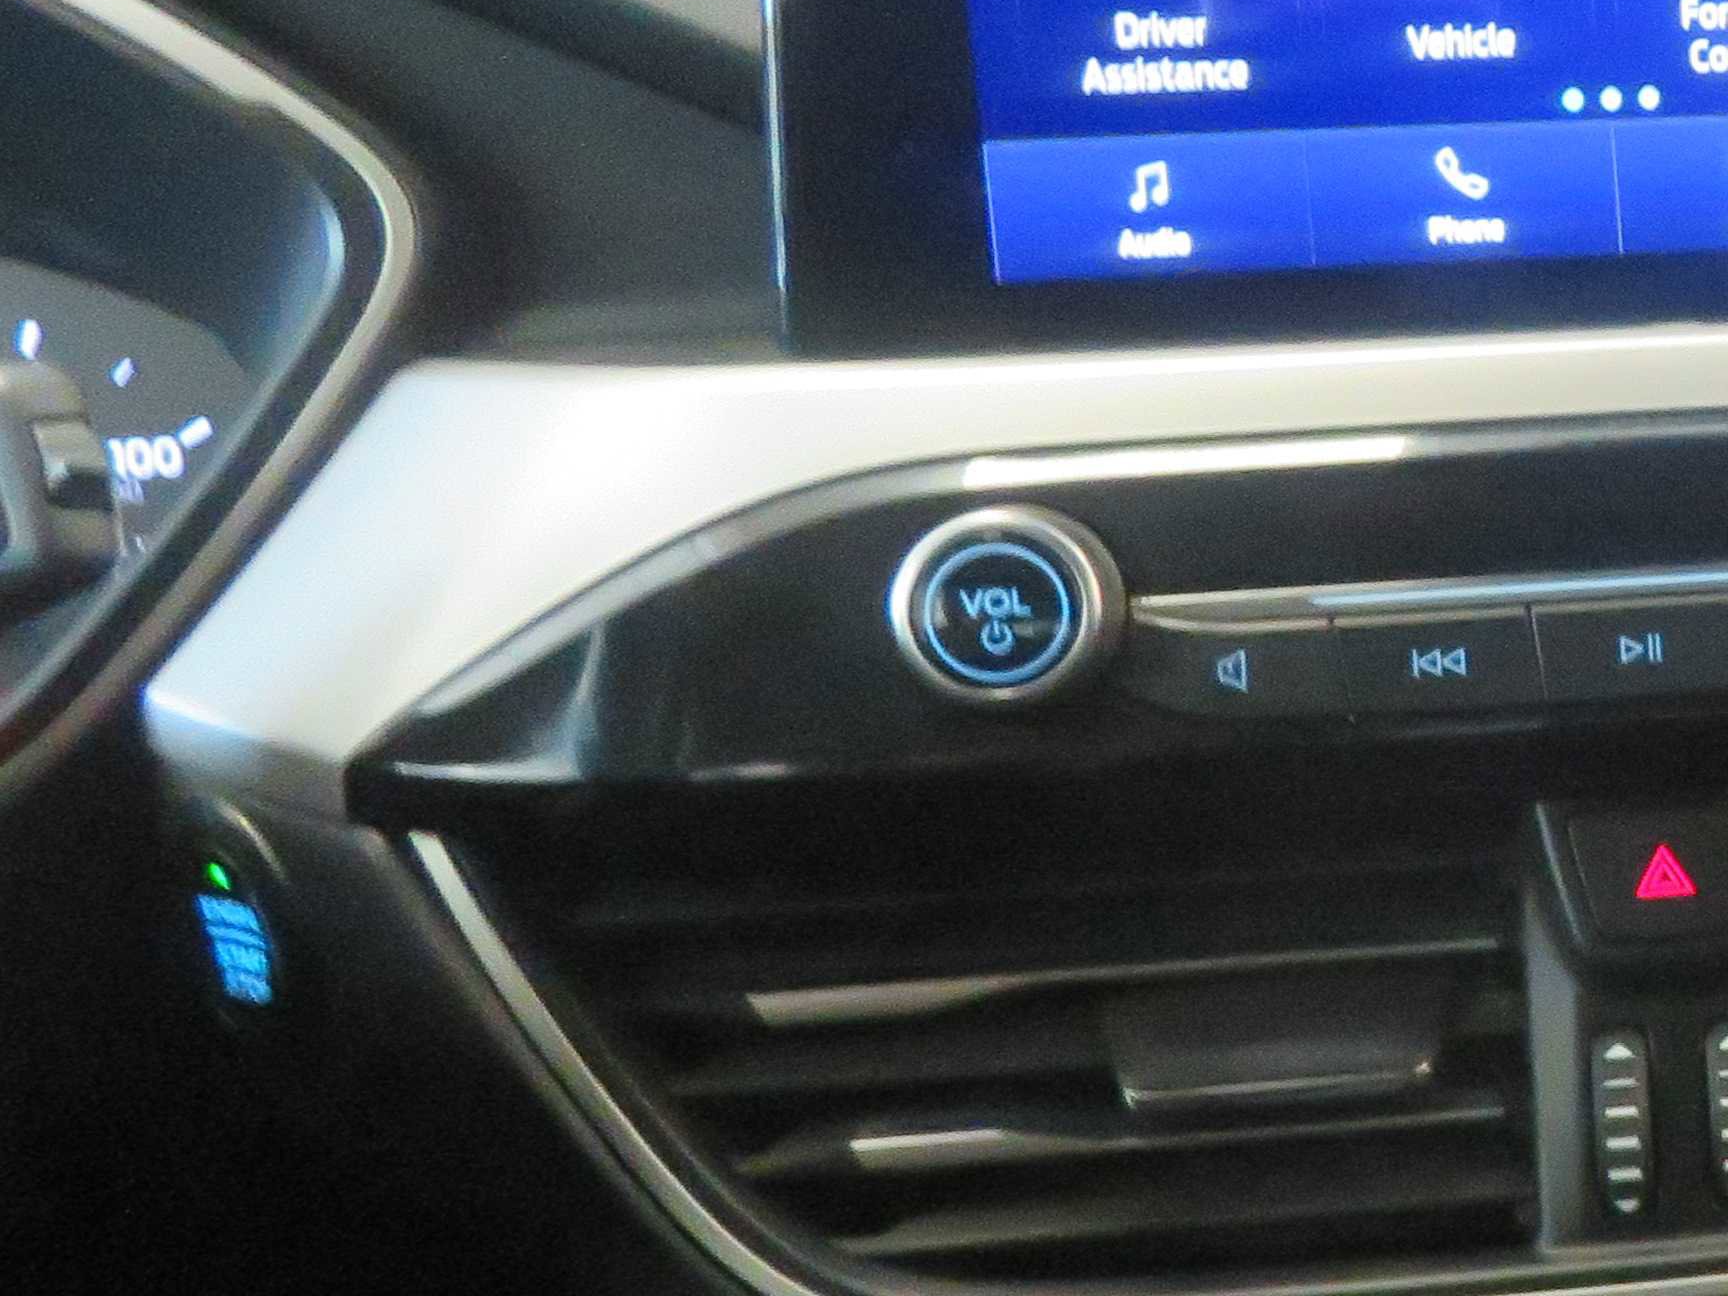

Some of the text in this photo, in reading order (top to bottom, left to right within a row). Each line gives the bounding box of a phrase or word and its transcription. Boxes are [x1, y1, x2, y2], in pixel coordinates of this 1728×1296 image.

[1114, 12, 1207, 50] Driver
[1406, 23, 1516, 61] Vehicle
[1082, 56, 1250, 95] Assistance
[1118, 228, 1193, 259] Audio
[1427, 214, 1506, 244] Phone
[106, 434, 184, 480] 100
[960, 587, 1032, 619] VOL
